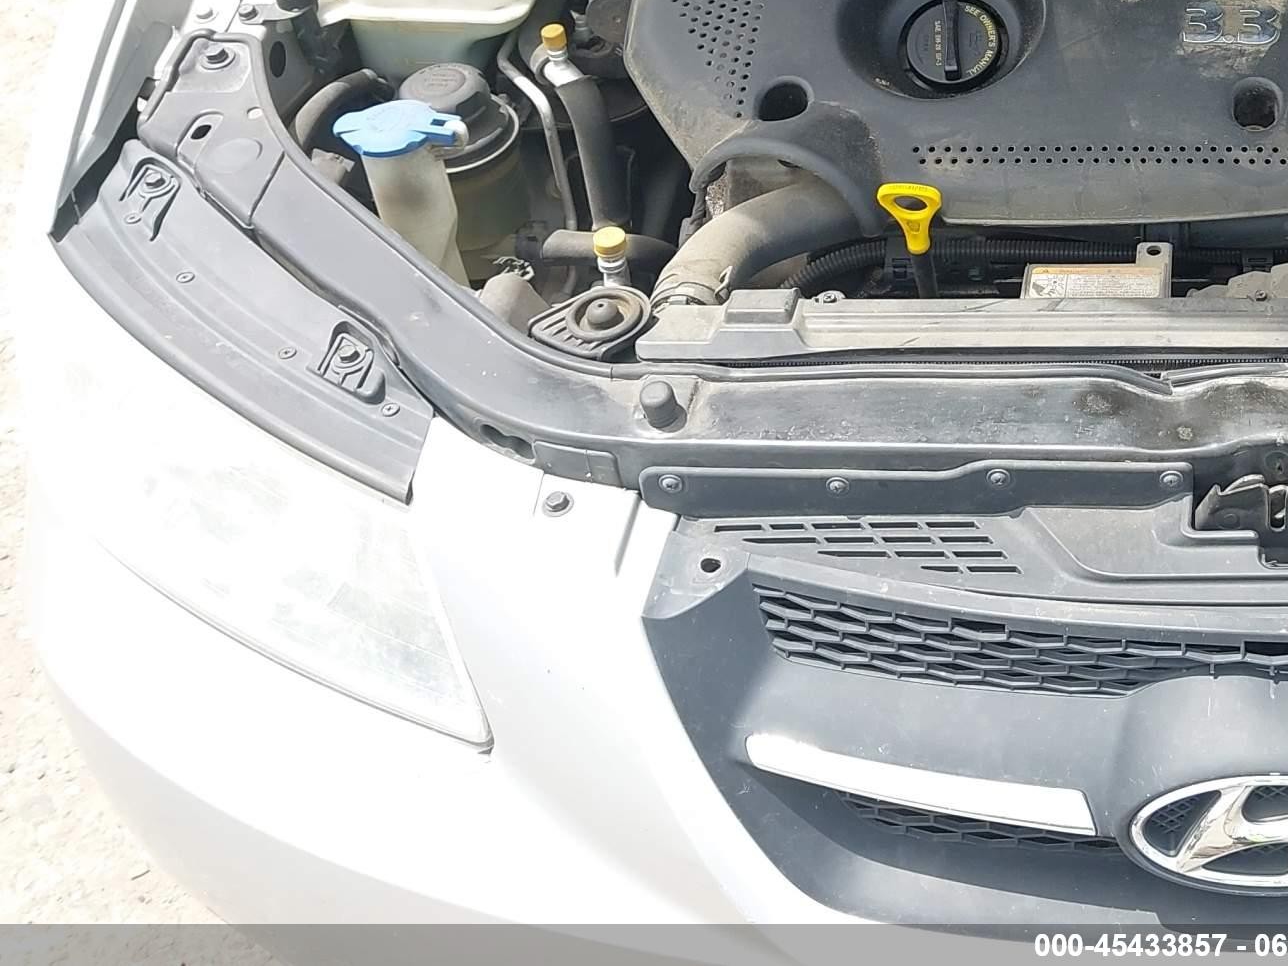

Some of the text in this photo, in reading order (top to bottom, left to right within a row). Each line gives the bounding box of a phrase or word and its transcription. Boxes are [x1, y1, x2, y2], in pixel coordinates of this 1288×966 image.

[965, 5, 996, 77] SEE OWNER'S MANUAL
[1181, 3, 1281, 44] 3.3
